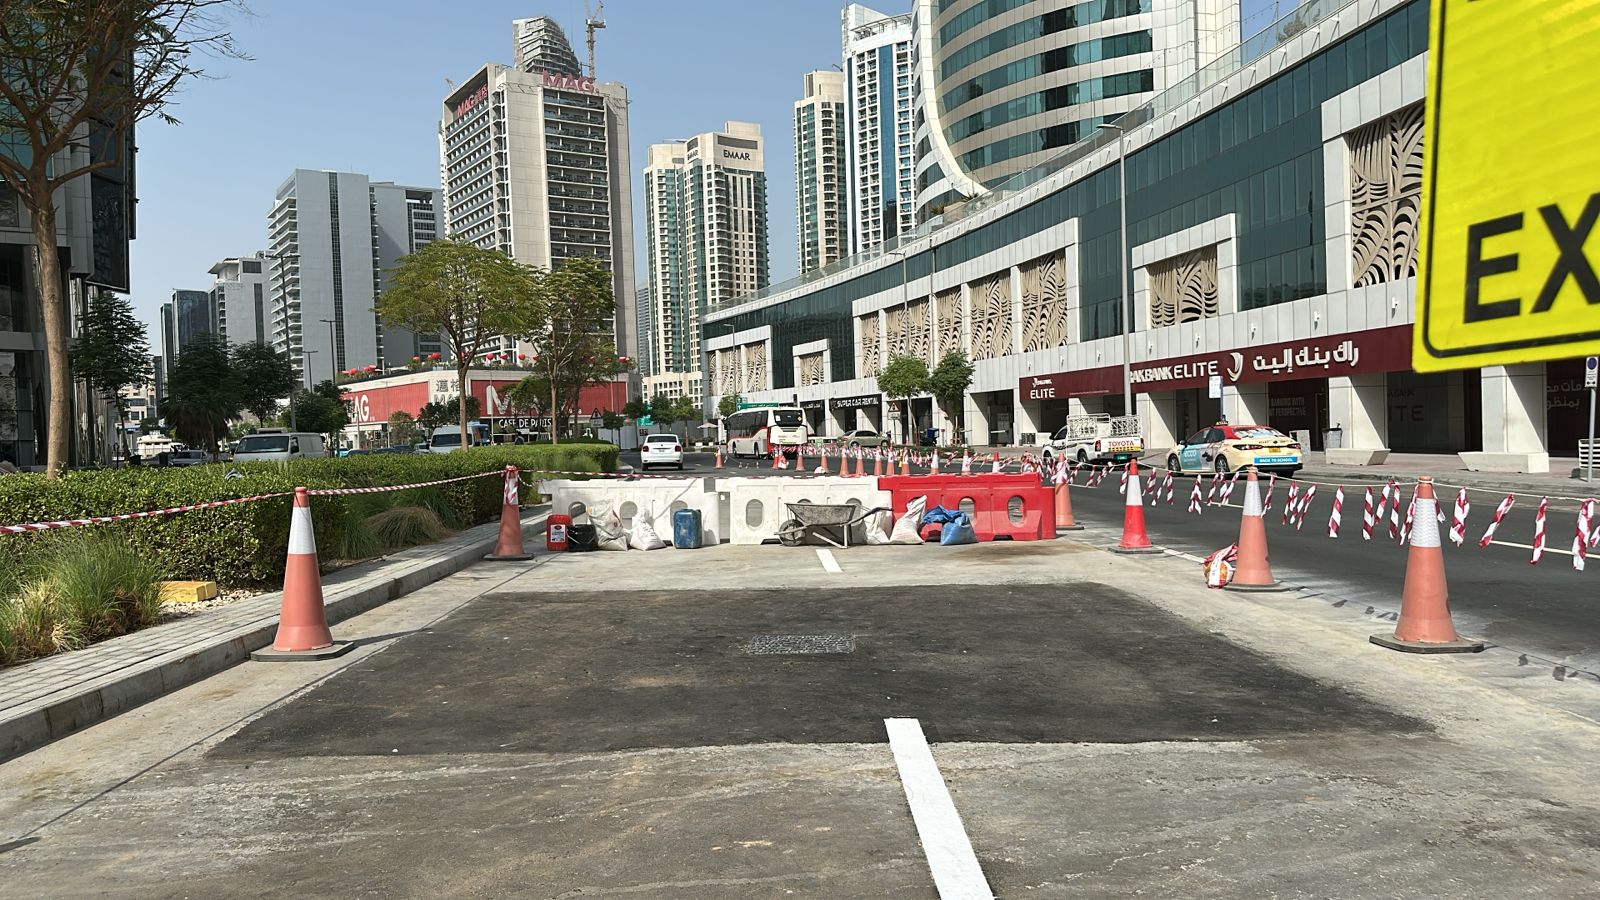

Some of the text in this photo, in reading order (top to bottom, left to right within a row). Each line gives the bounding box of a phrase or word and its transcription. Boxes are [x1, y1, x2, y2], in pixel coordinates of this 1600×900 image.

[543, 69, 594, 94] MAG
[723, 149, 750, 161] EMAAR
[1295, 346, 1330, 369] بنك
[1174, 360, 1218, 378] ELITE
[1030, 388, 1055, 399] ELITE
[518, 418, 529, 428] DE
